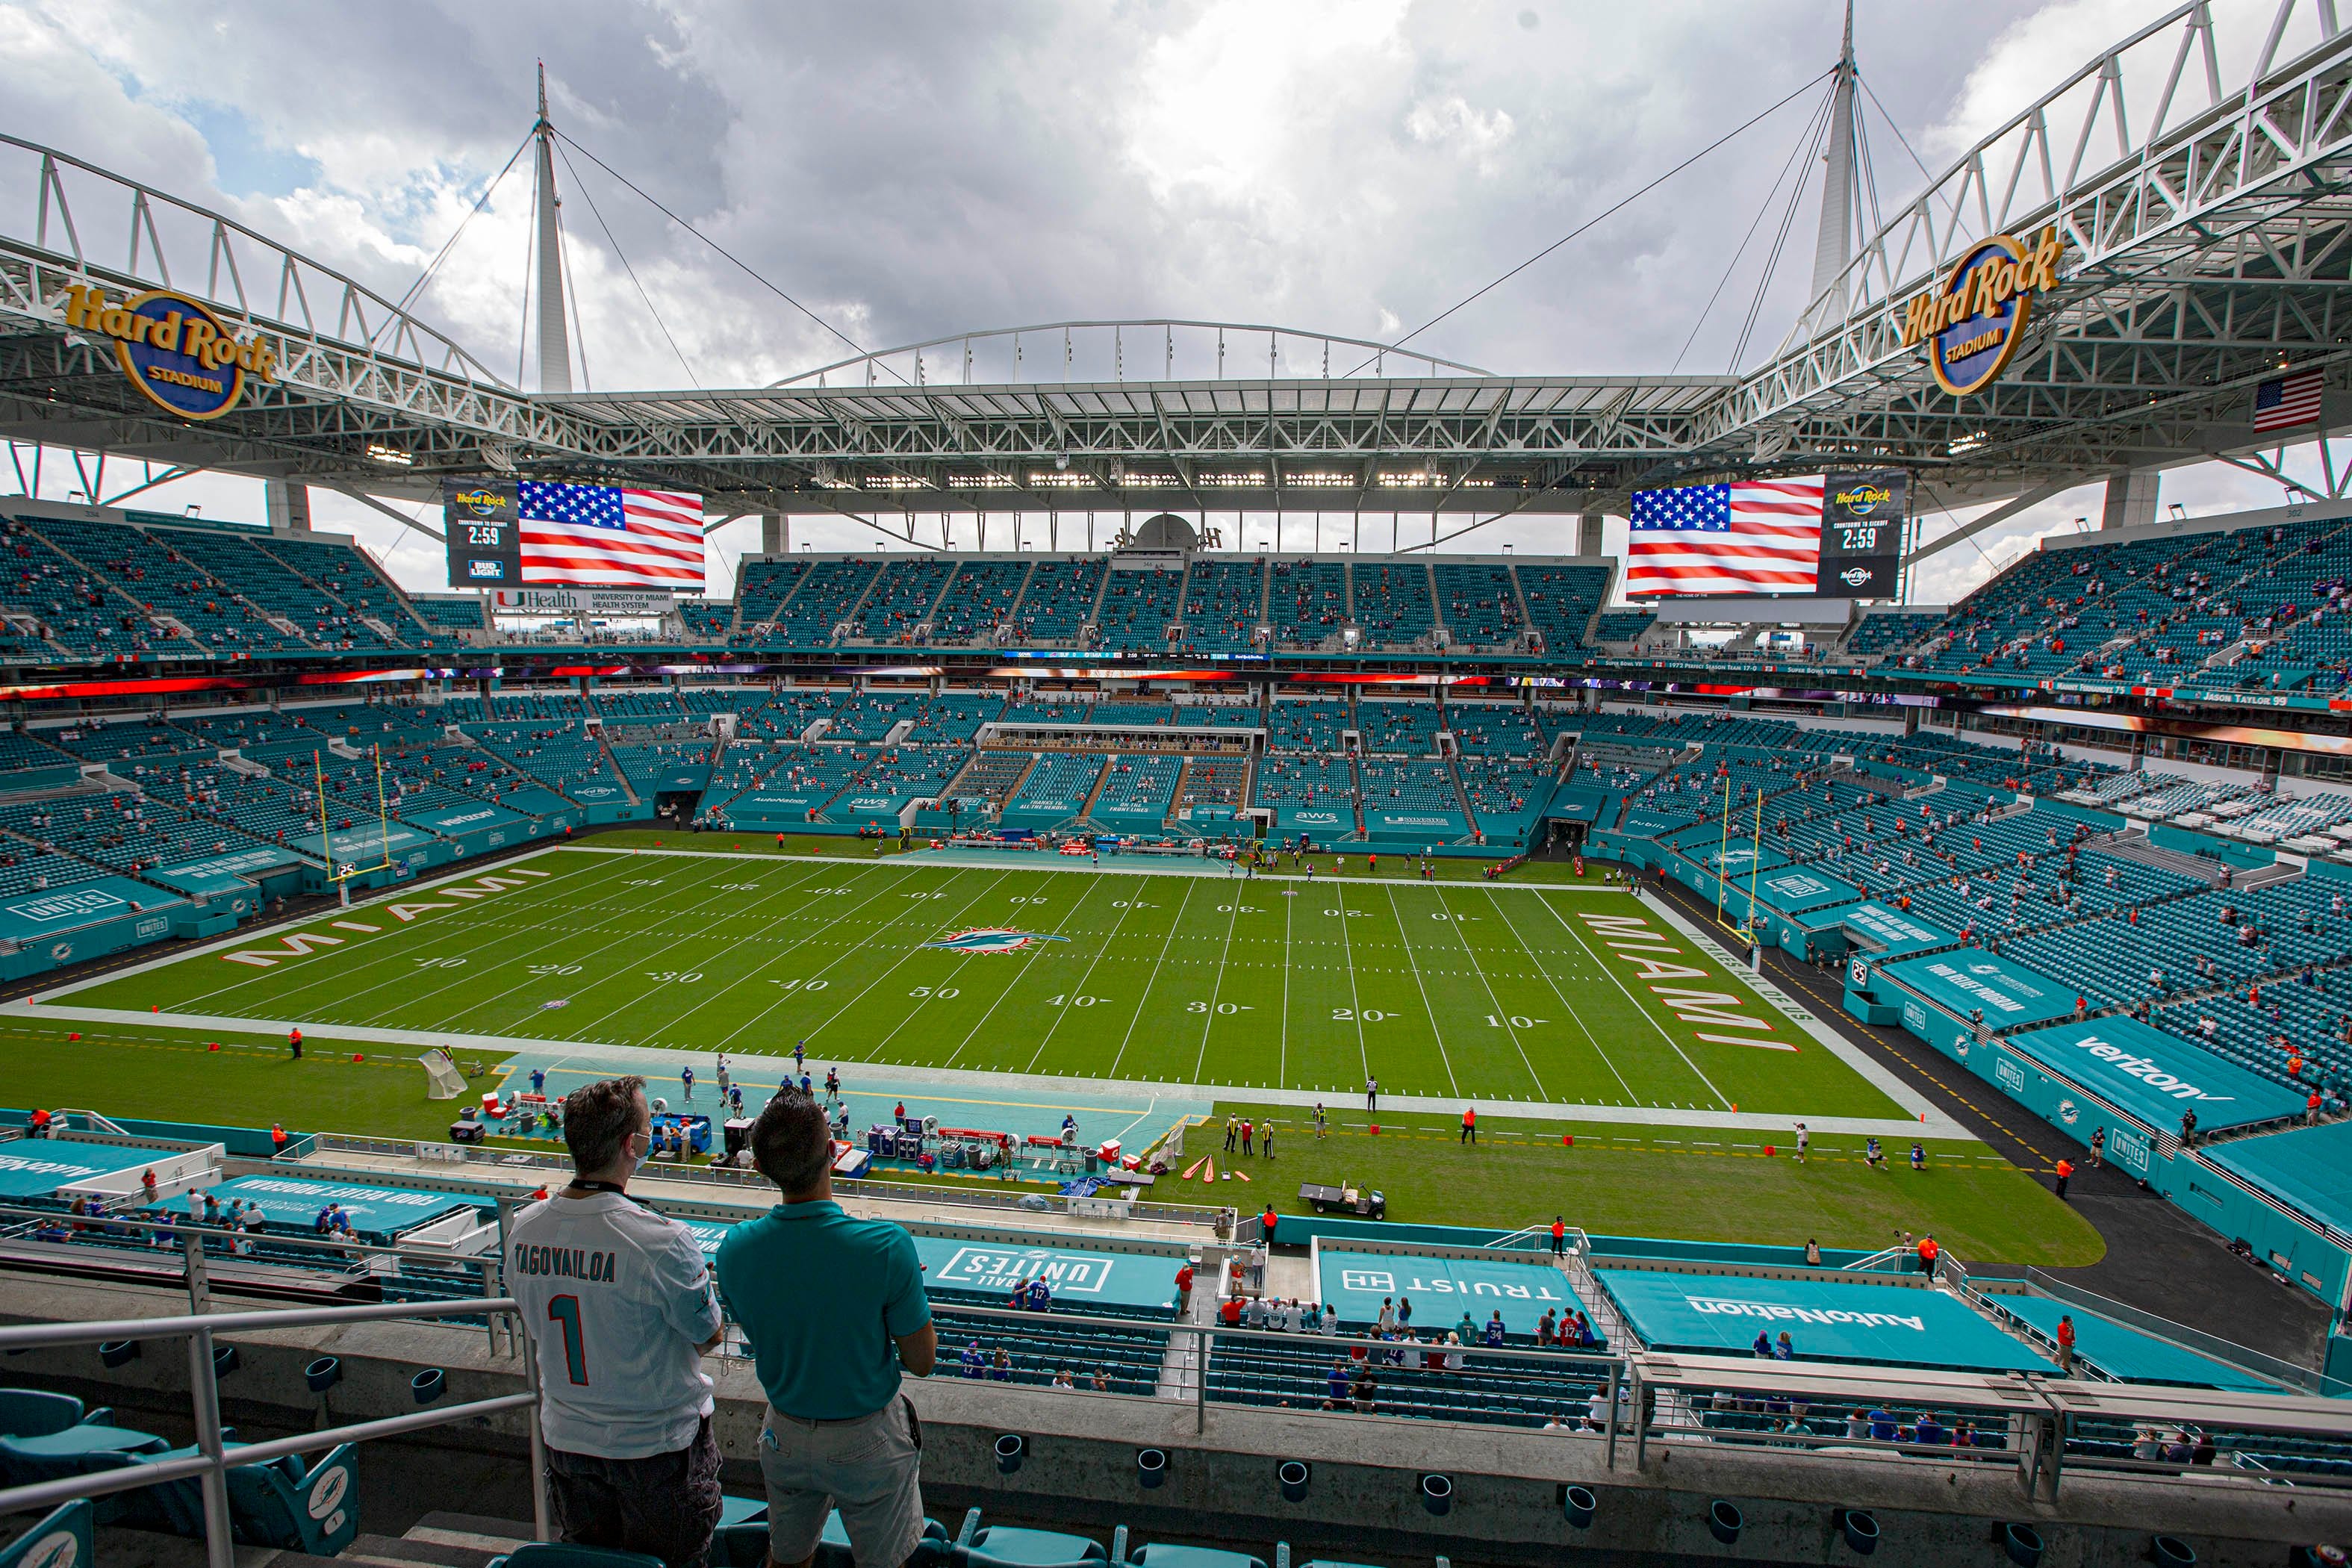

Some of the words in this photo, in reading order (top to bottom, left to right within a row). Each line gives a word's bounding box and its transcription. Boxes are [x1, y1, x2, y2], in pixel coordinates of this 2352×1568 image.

[1902, 267, 1979, 347] Hard
[1972, 226, 2065, 320] Rock
[65, 284, 182, 352] Hard
[183, 317, 277, 385] Rock
[1944, 327, 2004, 364] STADIUM
[147, 365, 223, 394] STADIUM
[456, 492, 482, 504] Hard
[482, 494, 507, 508] Rock
[1835, 491, 1864, 505] Hard
[1864, 488, 1891, 503] Rock
[2287, 509, 2303, 518] 302
[469, 526, 500, 546] 2:59
[1842, 527, 1878, 550] 2:59
[470, 568, 501, 576] LIGHT
[474, 561, 497, 570] BUD
[592, 593, 634, 601] UNIVERSITY
[2115, 684, 2125, 694] 75
[2272, 695, 2287, 706] 99
[752, 796, 808, 805] AutoNation
[851, 797, 890, 806] aws
[435, 809, 493, 827] verizon
[1295, 812, 1337, 820] aws
[729, 883, 760, 891] 20
[821, 887, 853, 896] 30
[1777, 877, 1818, 896] UNITES
[26, 894, 110, 917] UNITES
[1009, 896, 1048, 905] 50
[1112, 900, 1151, 909] 40
[1216, 904, 1255, 913] 30
[1323, 909, 1362, 918] 20
[220, 868, 551, 967] MIAMI
[1431, 912, 1471, 921] 10
[140, 921, 166, 934] UNITES
[423, 957, 467, 968] 10
[538, 963, 584, 976] 20
[657, 971, 704, 983] 30
[1853, 961, 1866, 981] 25
[780, 978, 829, 992] 40
[1576, 911, 1801, 1054] MIAMI
[1699, 941, 1744, 968] TAKES
[1737, 971, 1769, 987] ALL
[1761, 990, 1791, 1004] OF
[1781, 1007, 1815, 1021] US
[1924, 963, 1958, 977] FOOD
[1944, 973, 1984, 990] RELIEF
[1970, 986, 2026, 1012] PROGRAM
[908, 986, 960, 999] 50
[1045, 994, 1097, 1007] 40
[1186, 1001, 1238, 1015] 30
[1332, 1007, 1385, 1022] 20
[1483, 1015, 1535, 1028] 10
[1905, 1007, 1925, 1025] UNITES
[1998, 1064, 2021, 1086] UNITES
[2075, 1036, 2203, 1100] verizon
[1112, 1149, 1119, 1157] G
[2115, 1137, 2144, 1166] UNITES
[232, 1178, 333, 1196] PROGRAM
[326, 1186, 395, 1201] RELIEF
[389, 1193, 445, 1207] FOOD
[514, 1242, 616, 1284] TAGOVAILOA
[963, 1254, 1091, 1283] UNITES
[1033, 1289, 1045, 1299] 17
[1406, 1278, 1562, 1301] TRUIST
[1685, 1300, 1925, 1331] AutoNation
[1489, 1329, 1503, 1340] 34
[1564, 1327, 1575, 1338] 17
[547, 1293, 590, 1387] 1
